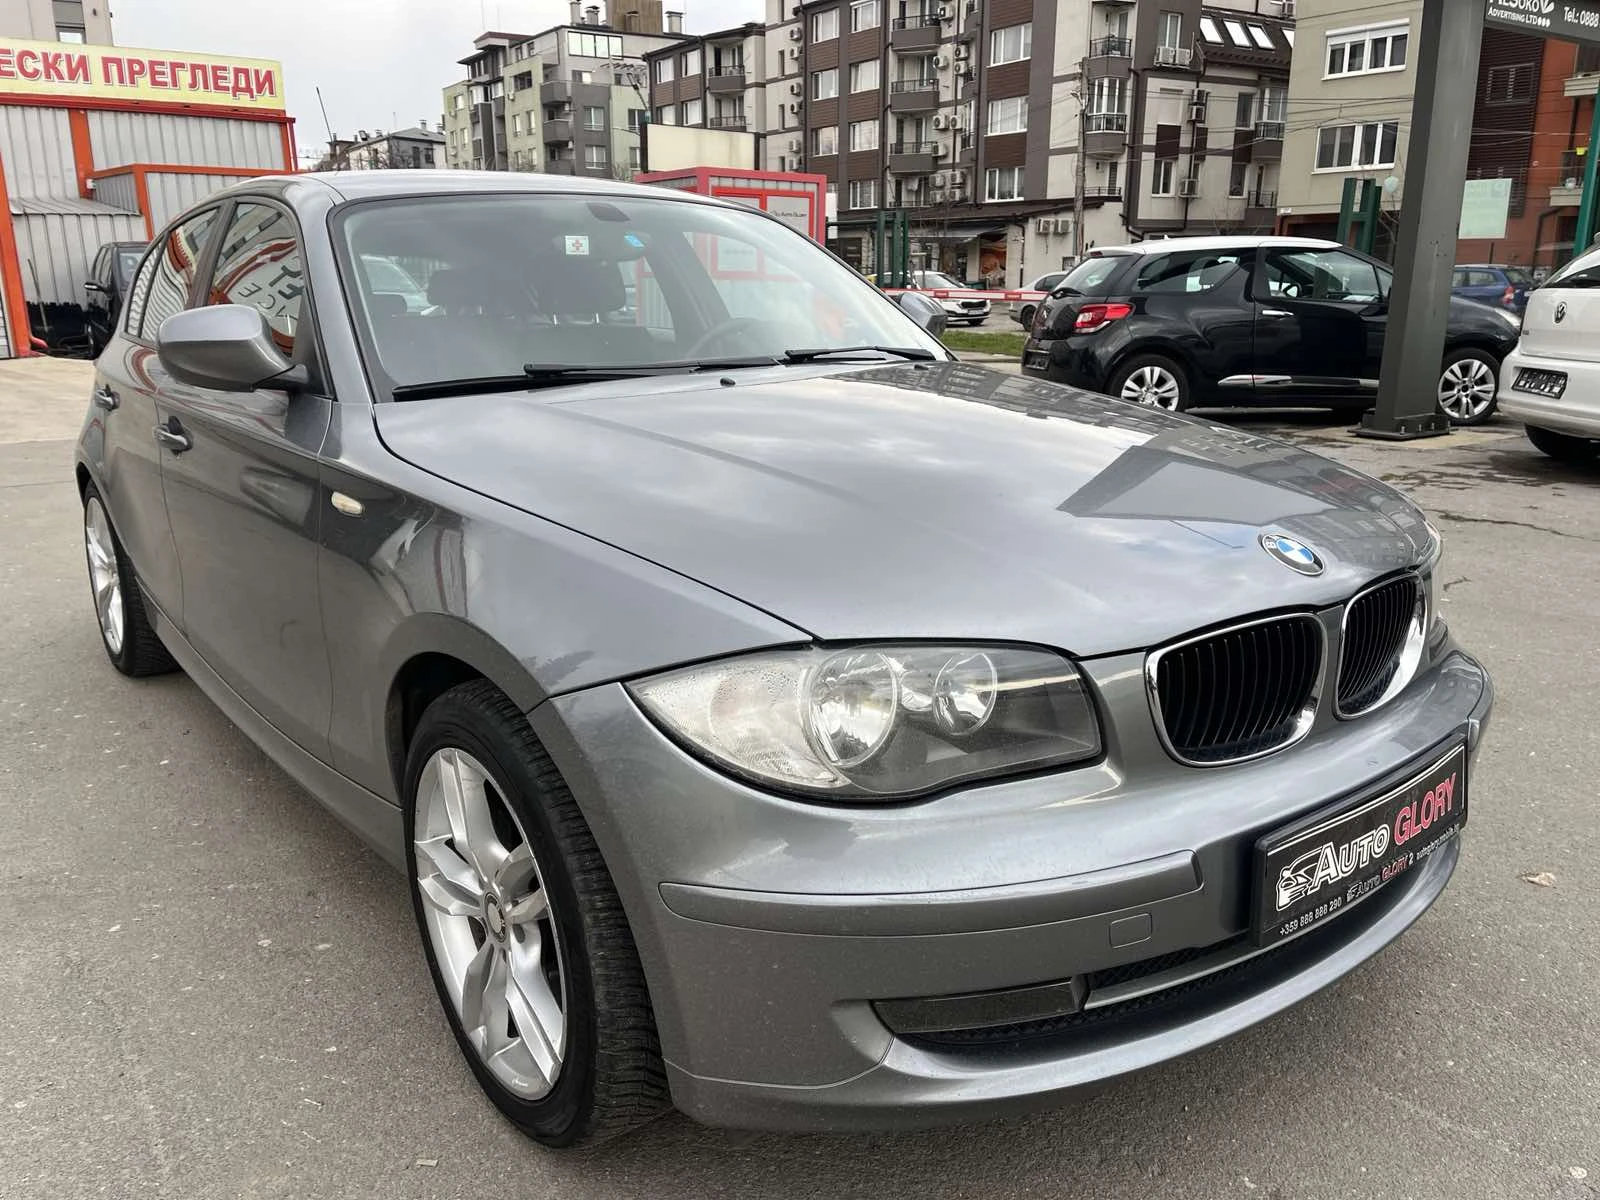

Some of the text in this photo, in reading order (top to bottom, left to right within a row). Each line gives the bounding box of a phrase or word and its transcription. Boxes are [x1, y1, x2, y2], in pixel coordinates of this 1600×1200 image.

[1488, 6, 1538, 25] ADVERTISING LTD
[101, 55, 276, 100] ПРЕГЛЕДИ
[1306, 772, 1456, 896] AUTO GLORY
[1279, 919, 1299, 936] +359
[1300, 911, 1314, 927] 888
[1315, 904, 1328, 919] 888
[1329, 896, 1342, 912] 290
[1382, 854, 1409, 881] GLORY
[1408, 852, 1414, 866] 2
